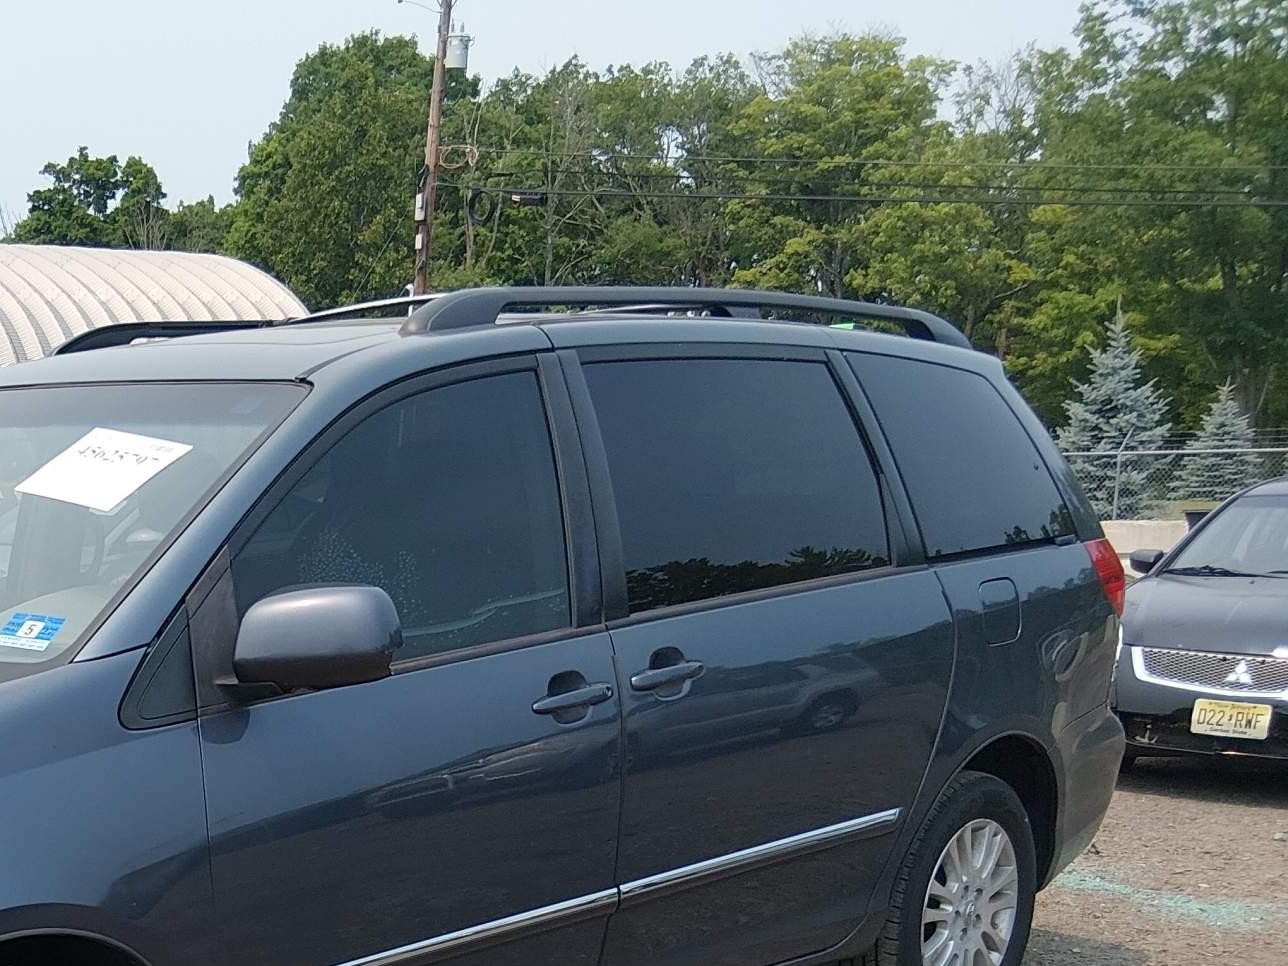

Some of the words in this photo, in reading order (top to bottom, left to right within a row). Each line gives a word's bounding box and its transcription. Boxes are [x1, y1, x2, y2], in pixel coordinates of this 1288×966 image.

[24, 623, 37, 636] 5
[1197, 708, 1226, 727] D22
[1234, 711, 1265, 729] RWF
